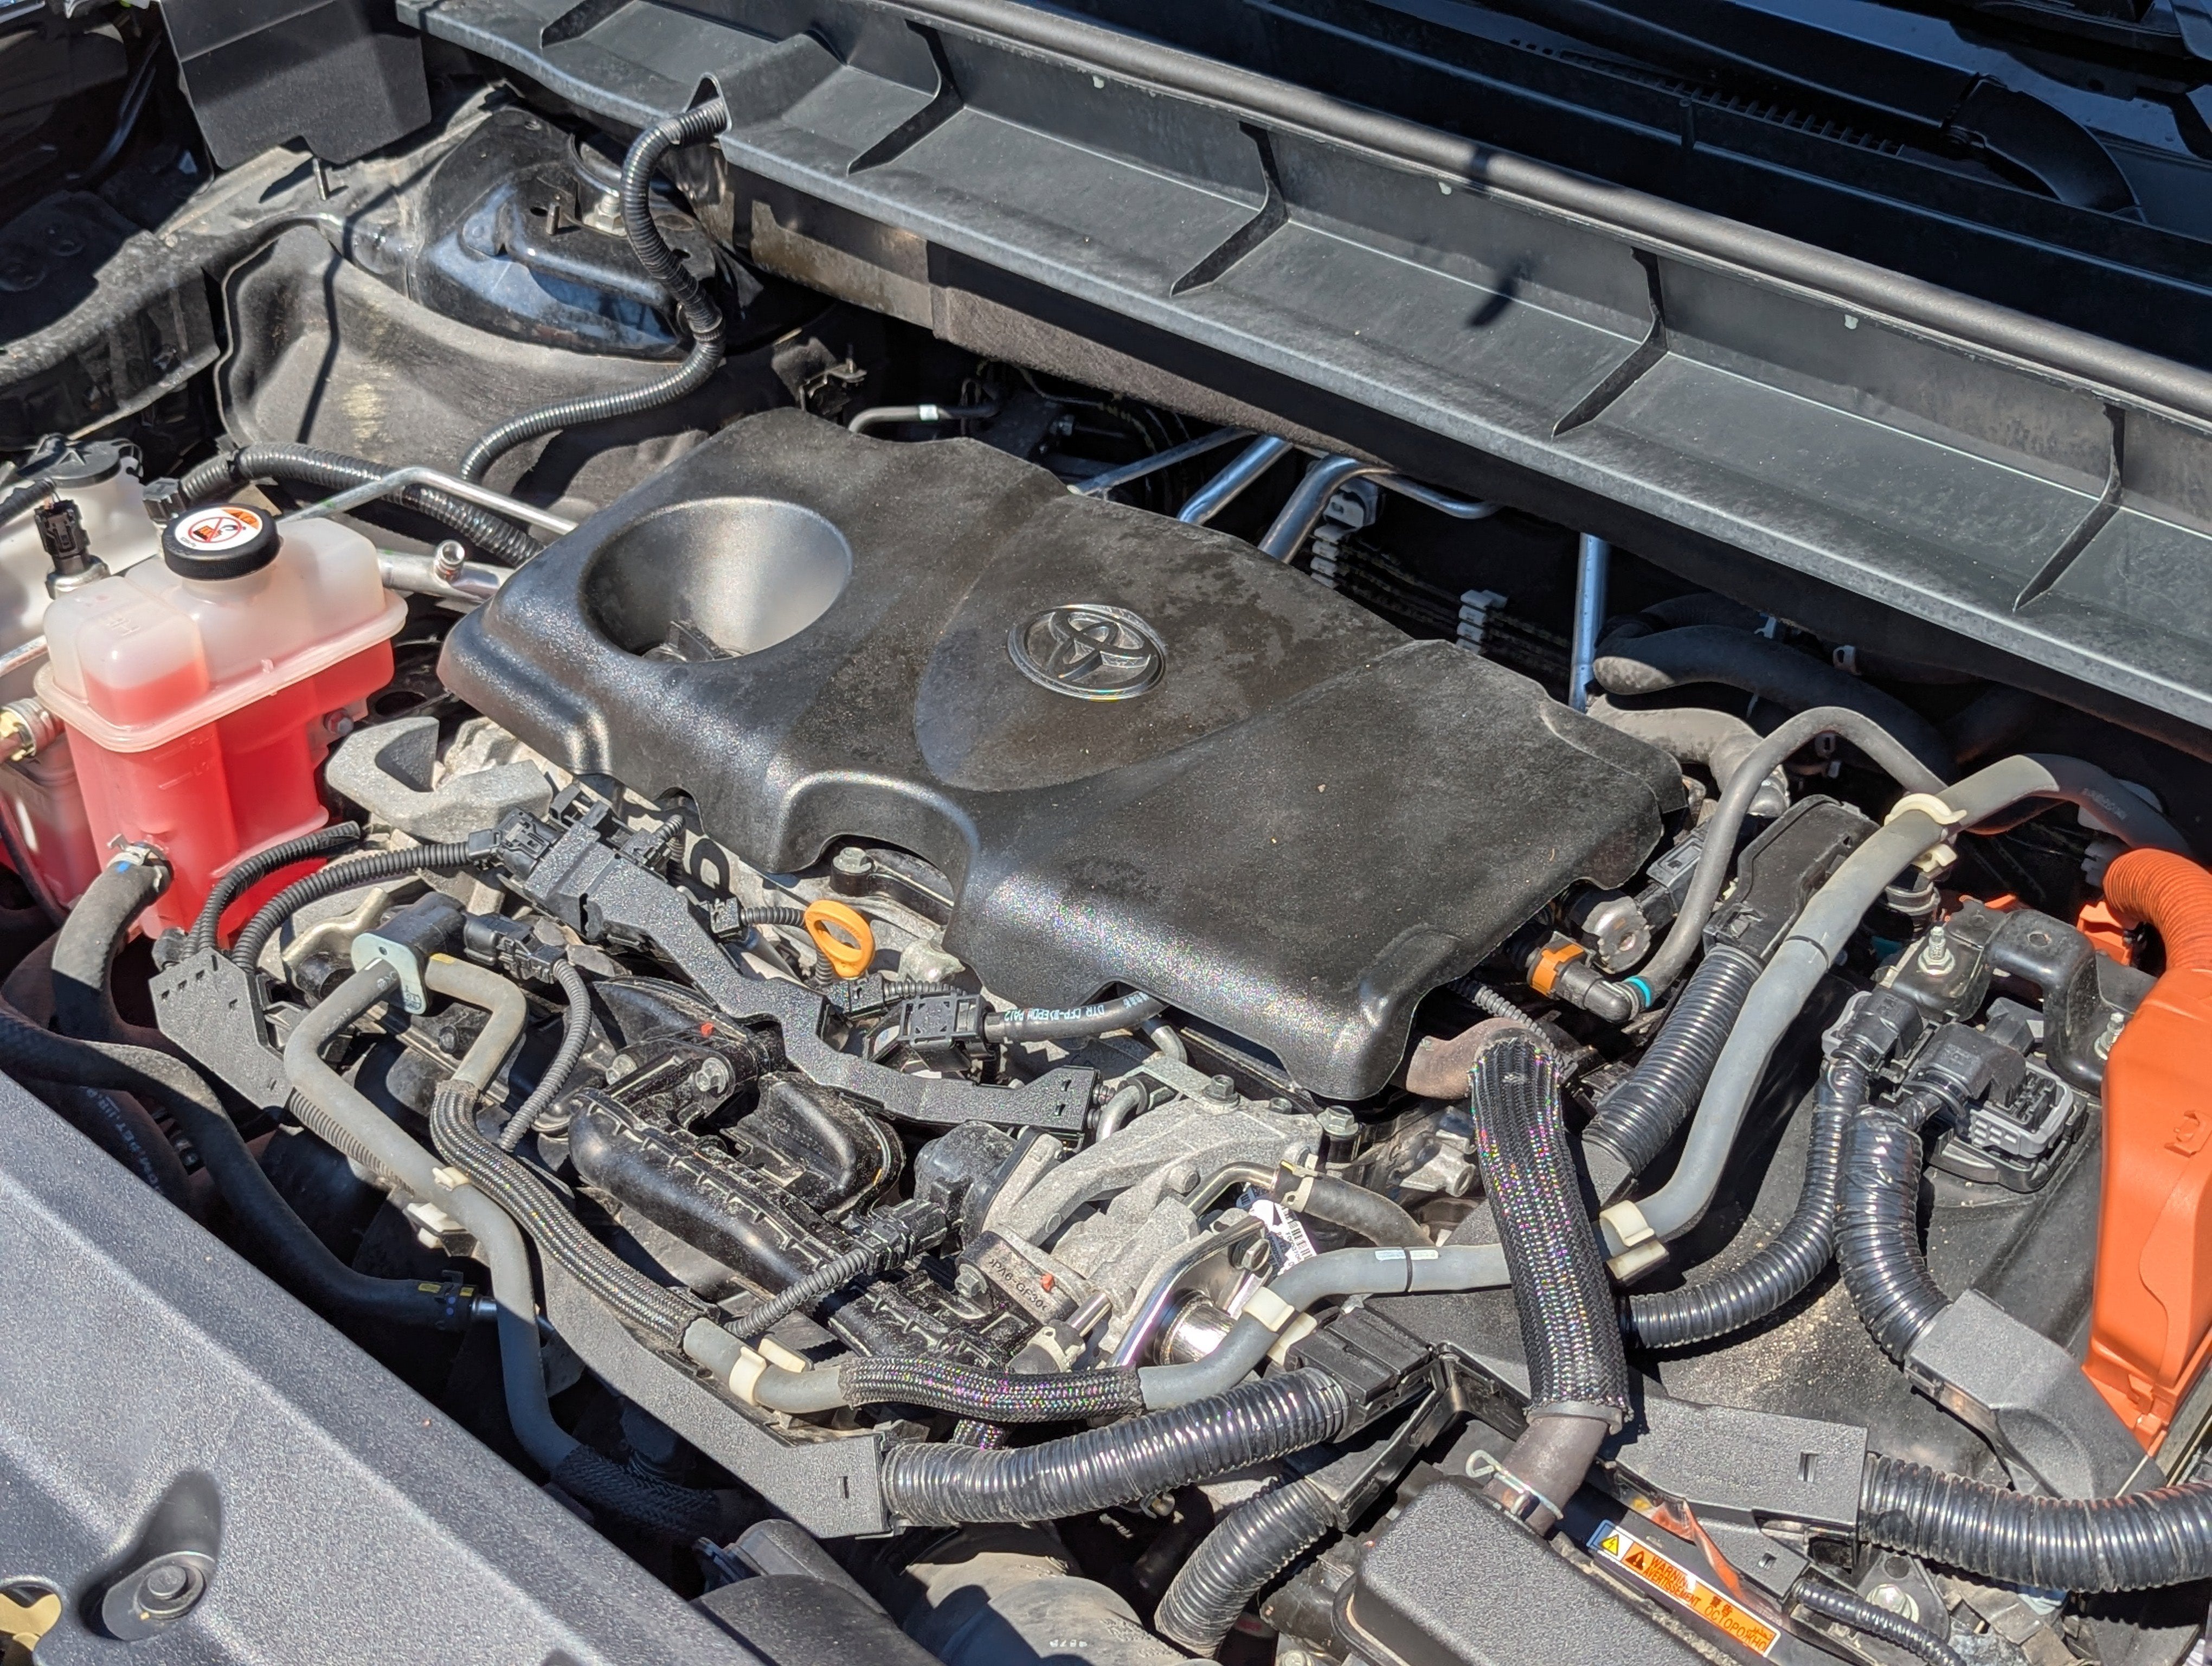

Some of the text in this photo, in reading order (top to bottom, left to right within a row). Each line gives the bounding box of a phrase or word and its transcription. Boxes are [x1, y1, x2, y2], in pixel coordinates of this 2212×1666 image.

[1644, 1566, 1701, 1607] AVERTISSEMENT
[1651, 1556, 1690, 1589] WARNIN
[1704, 1605, 1767, 1652] ОСТОРОЖНО
